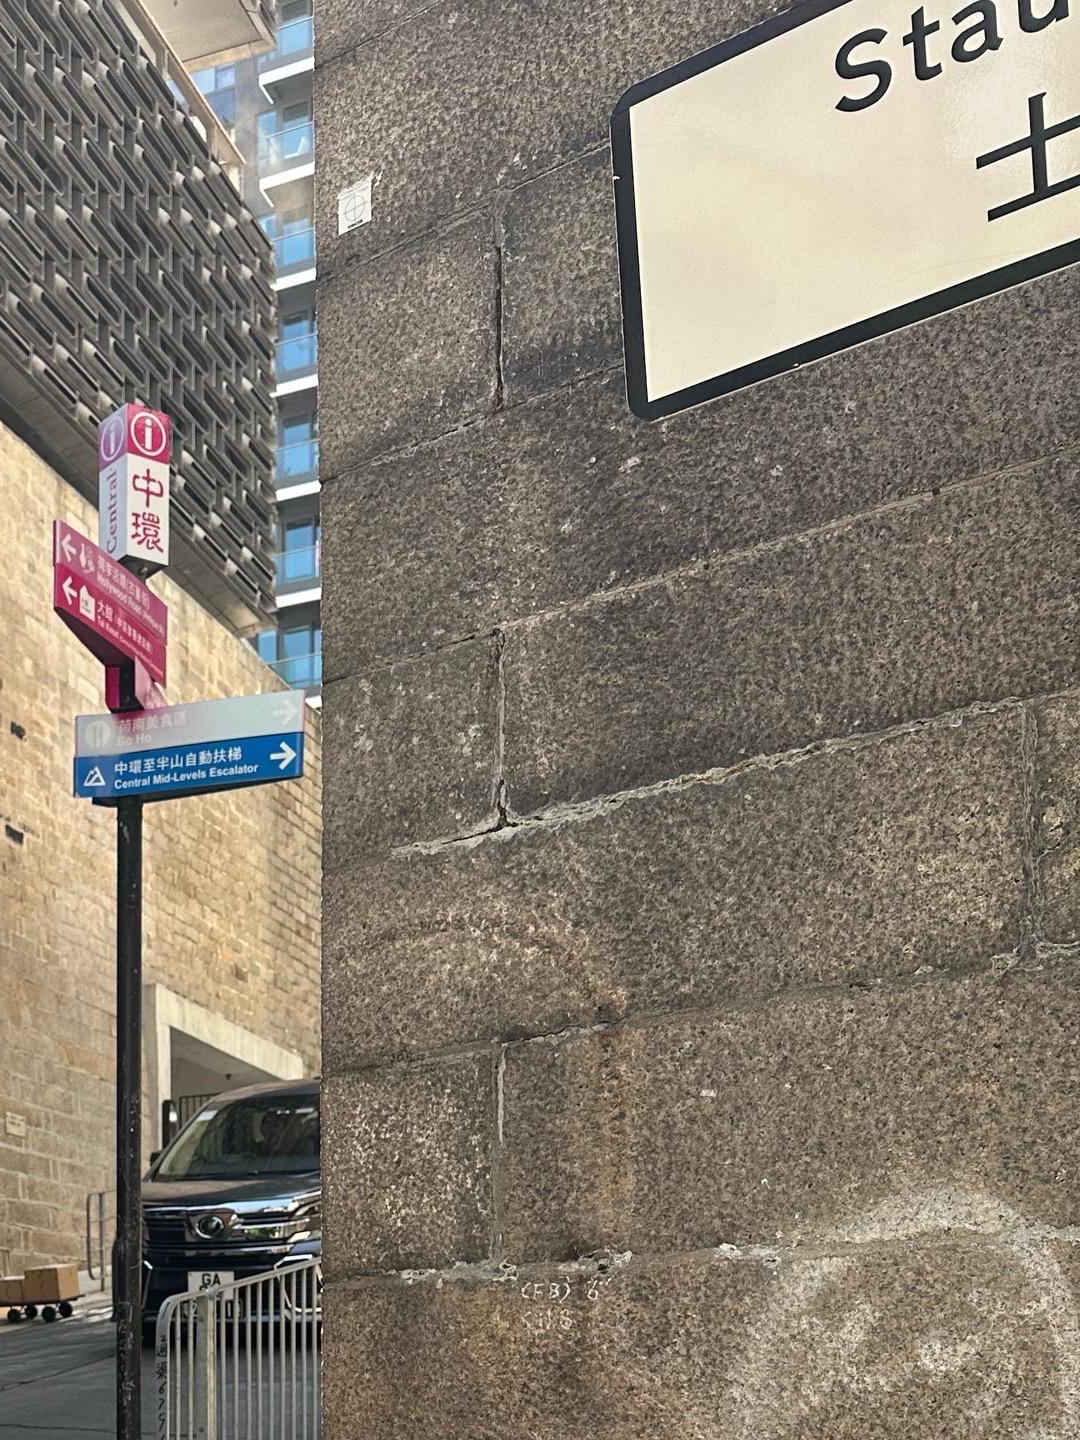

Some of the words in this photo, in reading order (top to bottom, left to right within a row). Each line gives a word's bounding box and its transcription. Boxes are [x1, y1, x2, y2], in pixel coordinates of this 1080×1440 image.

[834, 0, 1070, 113] Stau
[106, 468, 118, 554] Central
[131, 468, 164, 553] 中環
[114, 746, 242, 776] 中環至半山自動扶梯
[114, 776, 151, 790] Central
[152, 769, 207, 786] Mid-Levels
[209, 763, 259, 778] Escalator
[201, 1273, 221, 1287] GA
